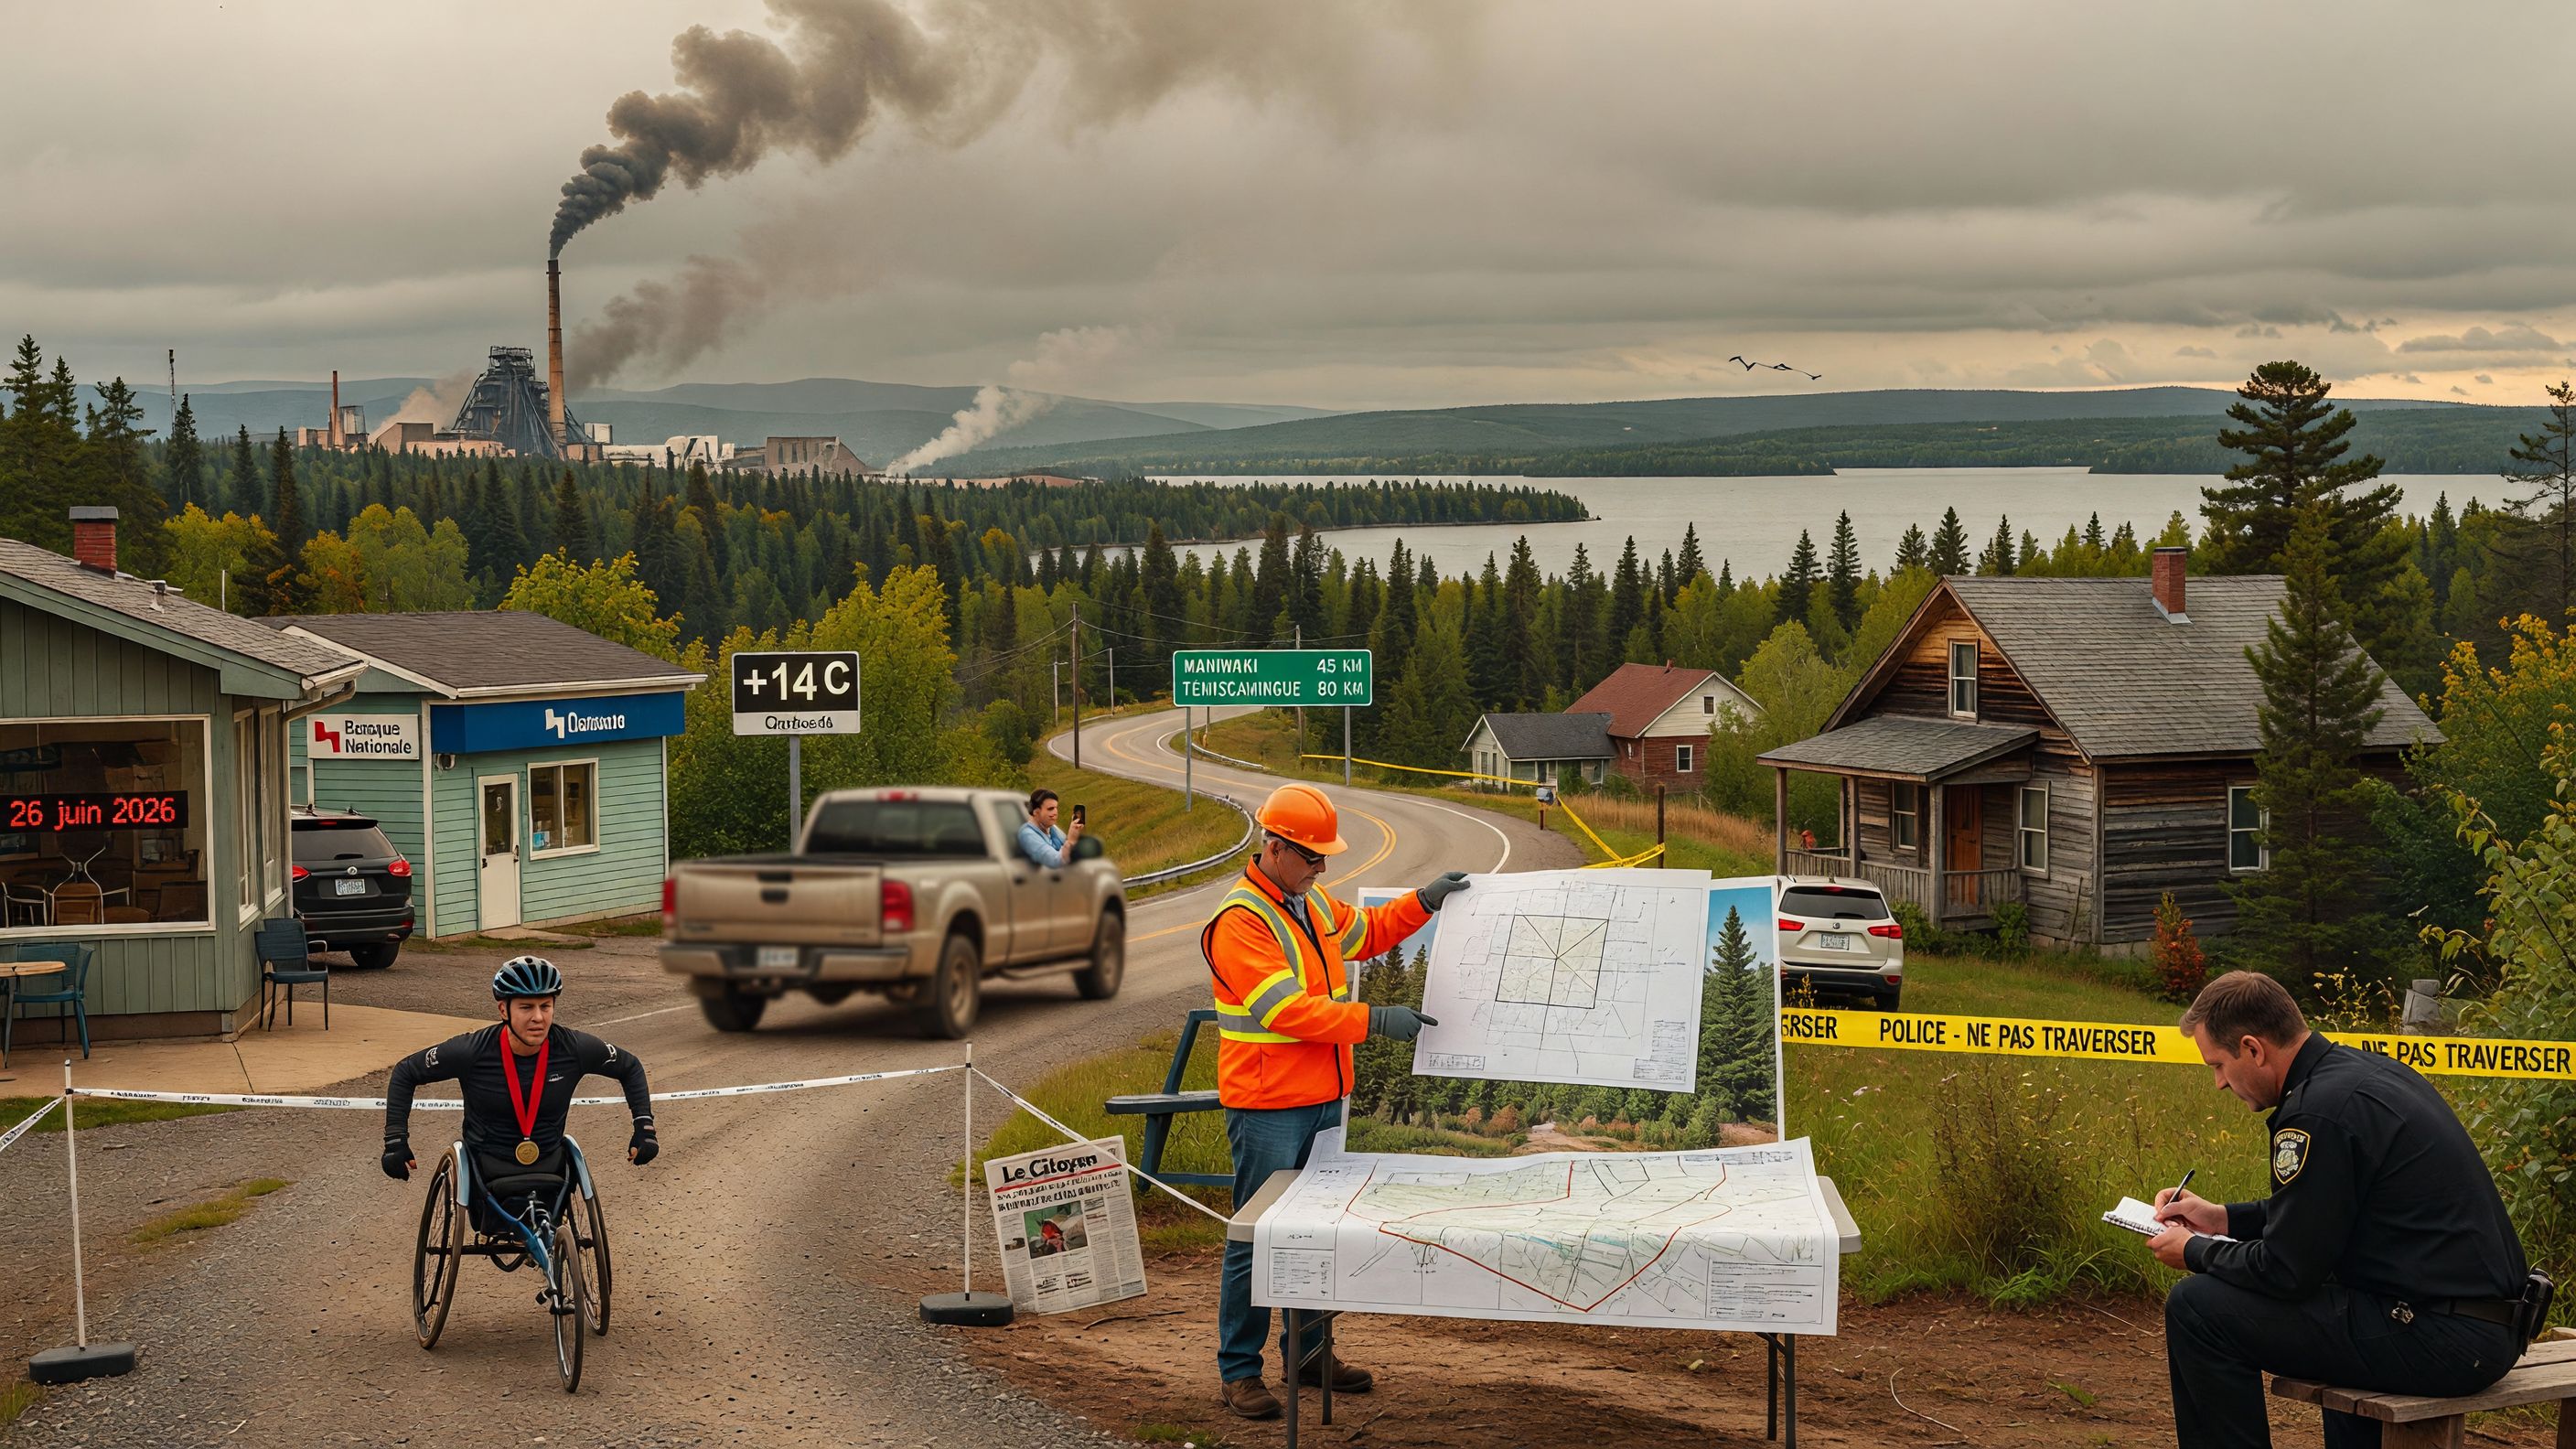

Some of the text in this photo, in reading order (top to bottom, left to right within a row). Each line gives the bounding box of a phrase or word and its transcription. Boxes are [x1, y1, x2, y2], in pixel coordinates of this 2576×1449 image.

[1184, 658, 1362, 673] MANIWAKI 45 KM
[1317, 681, 1337, 697] 80
[1343, 681, 1363, 696] KM
[345, 738, 412, 754] Nationale
[10, 797, 176, 832] 26 juin 2026
[1880, 1017, 1947, 1045] POLICE
[1967, 1022, 1991, 1046] NE
[1998, 1024, 2034, 1049] PAS
[2042, 1025, 2156, 1055] TRAVERSER
[2397, 1041, 2436, 1068] PAS
[2444, 1043, 2571, 1074] TRAVERSER
[1002, 1165, 1025, 1183] Le
